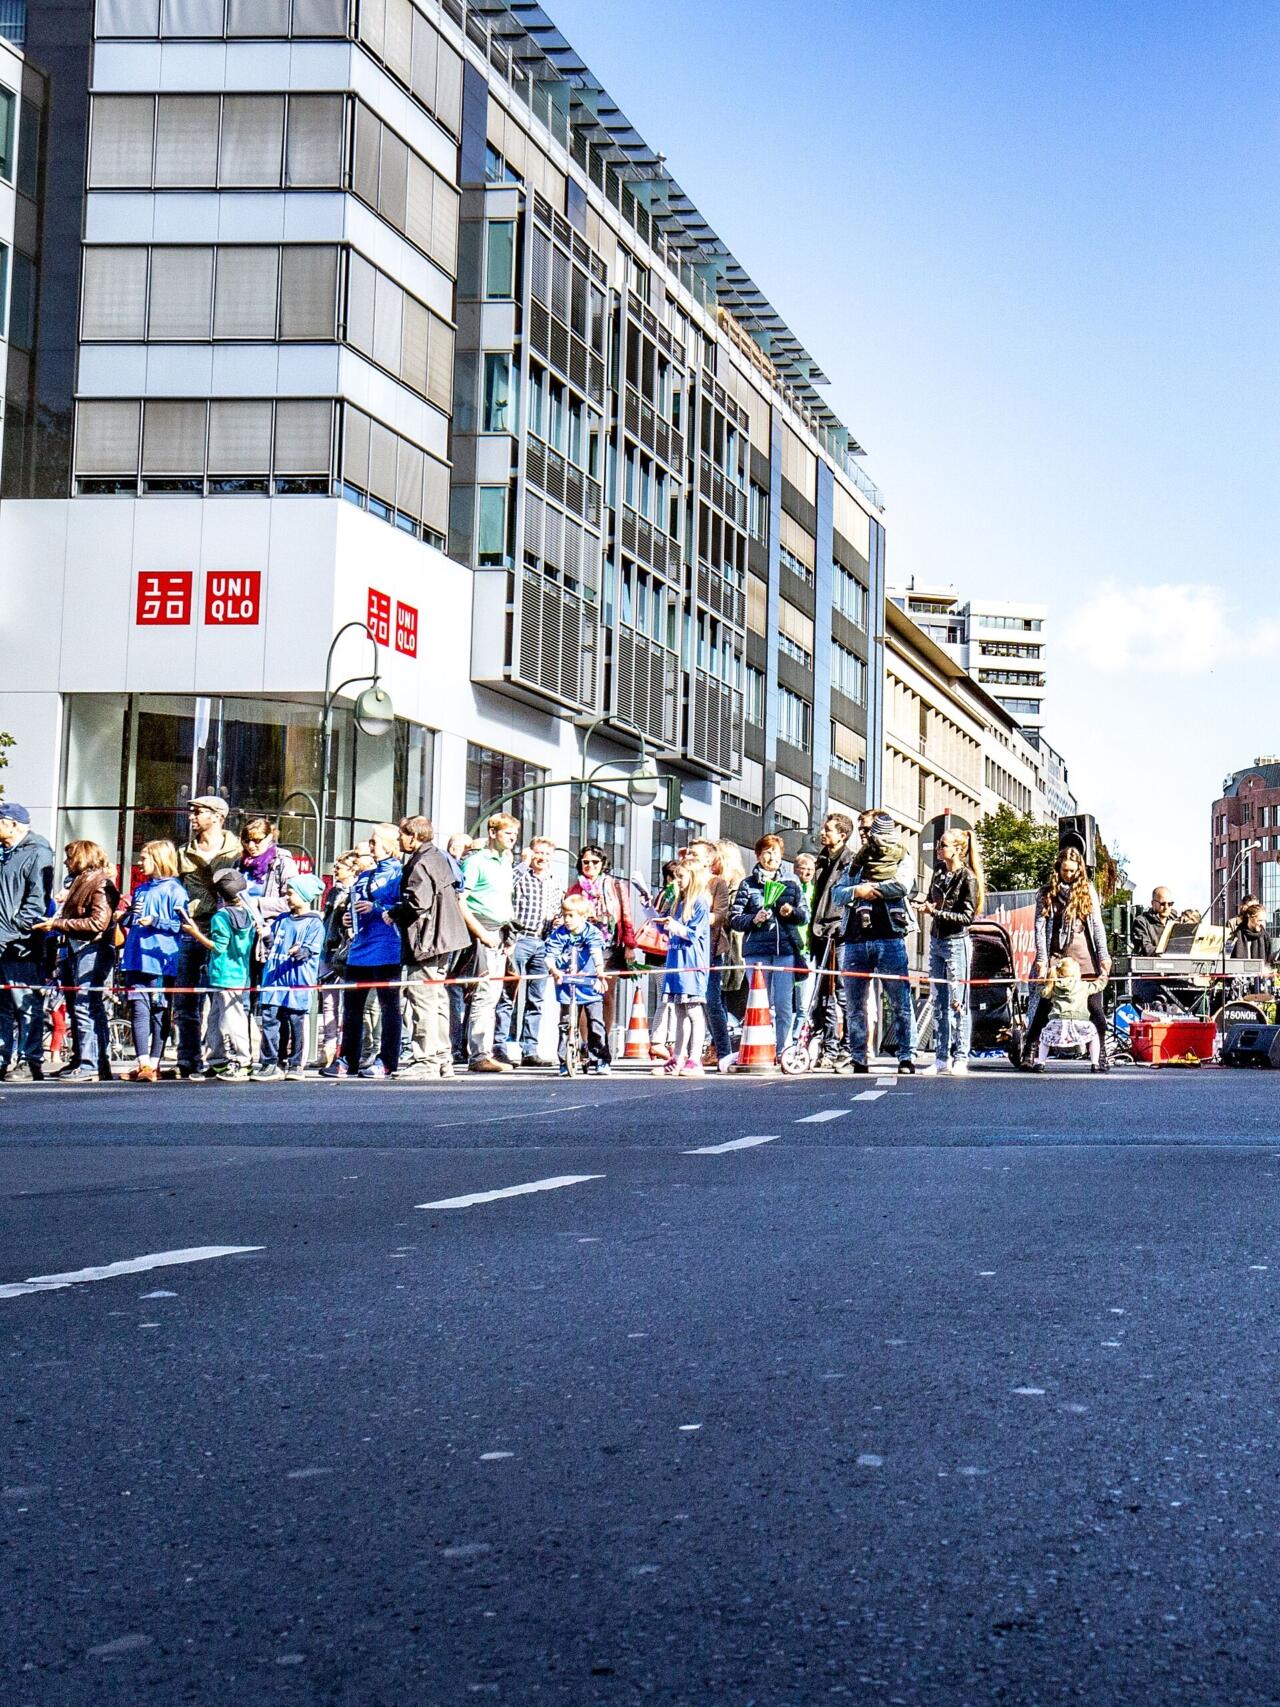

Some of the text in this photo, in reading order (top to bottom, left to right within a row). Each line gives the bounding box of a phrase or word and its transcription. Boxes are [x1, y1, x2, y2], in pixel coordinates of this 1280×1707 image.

[212, 578, 251, 597] UNI
[211, 600, 254, 621] QLO
[397, 607, 415, 631] UNI
[397, 628, 416, 651] QLO
